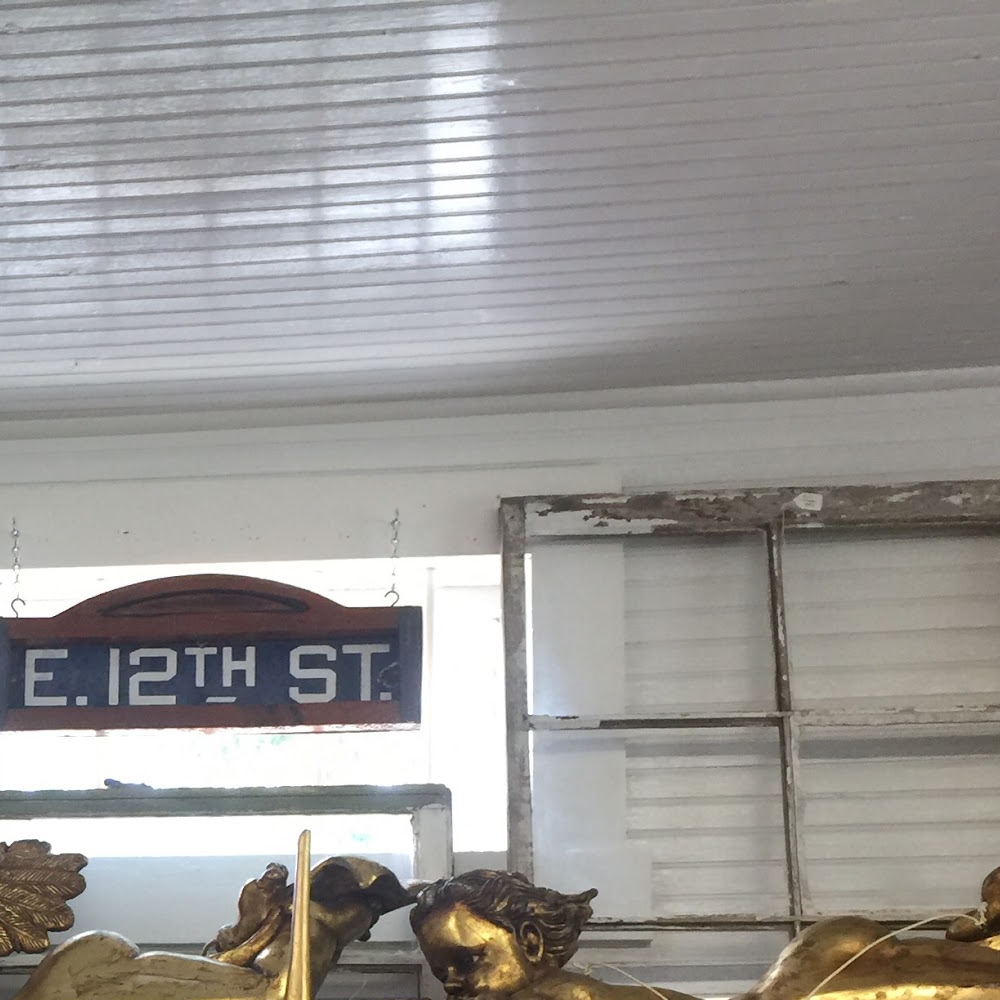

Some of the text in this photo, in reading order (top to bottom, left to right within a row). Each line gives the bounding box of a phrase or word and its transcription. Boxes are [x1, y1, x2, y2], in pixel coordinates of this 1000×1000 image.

[24, 644, 392, 706] E. 12TH ST.
